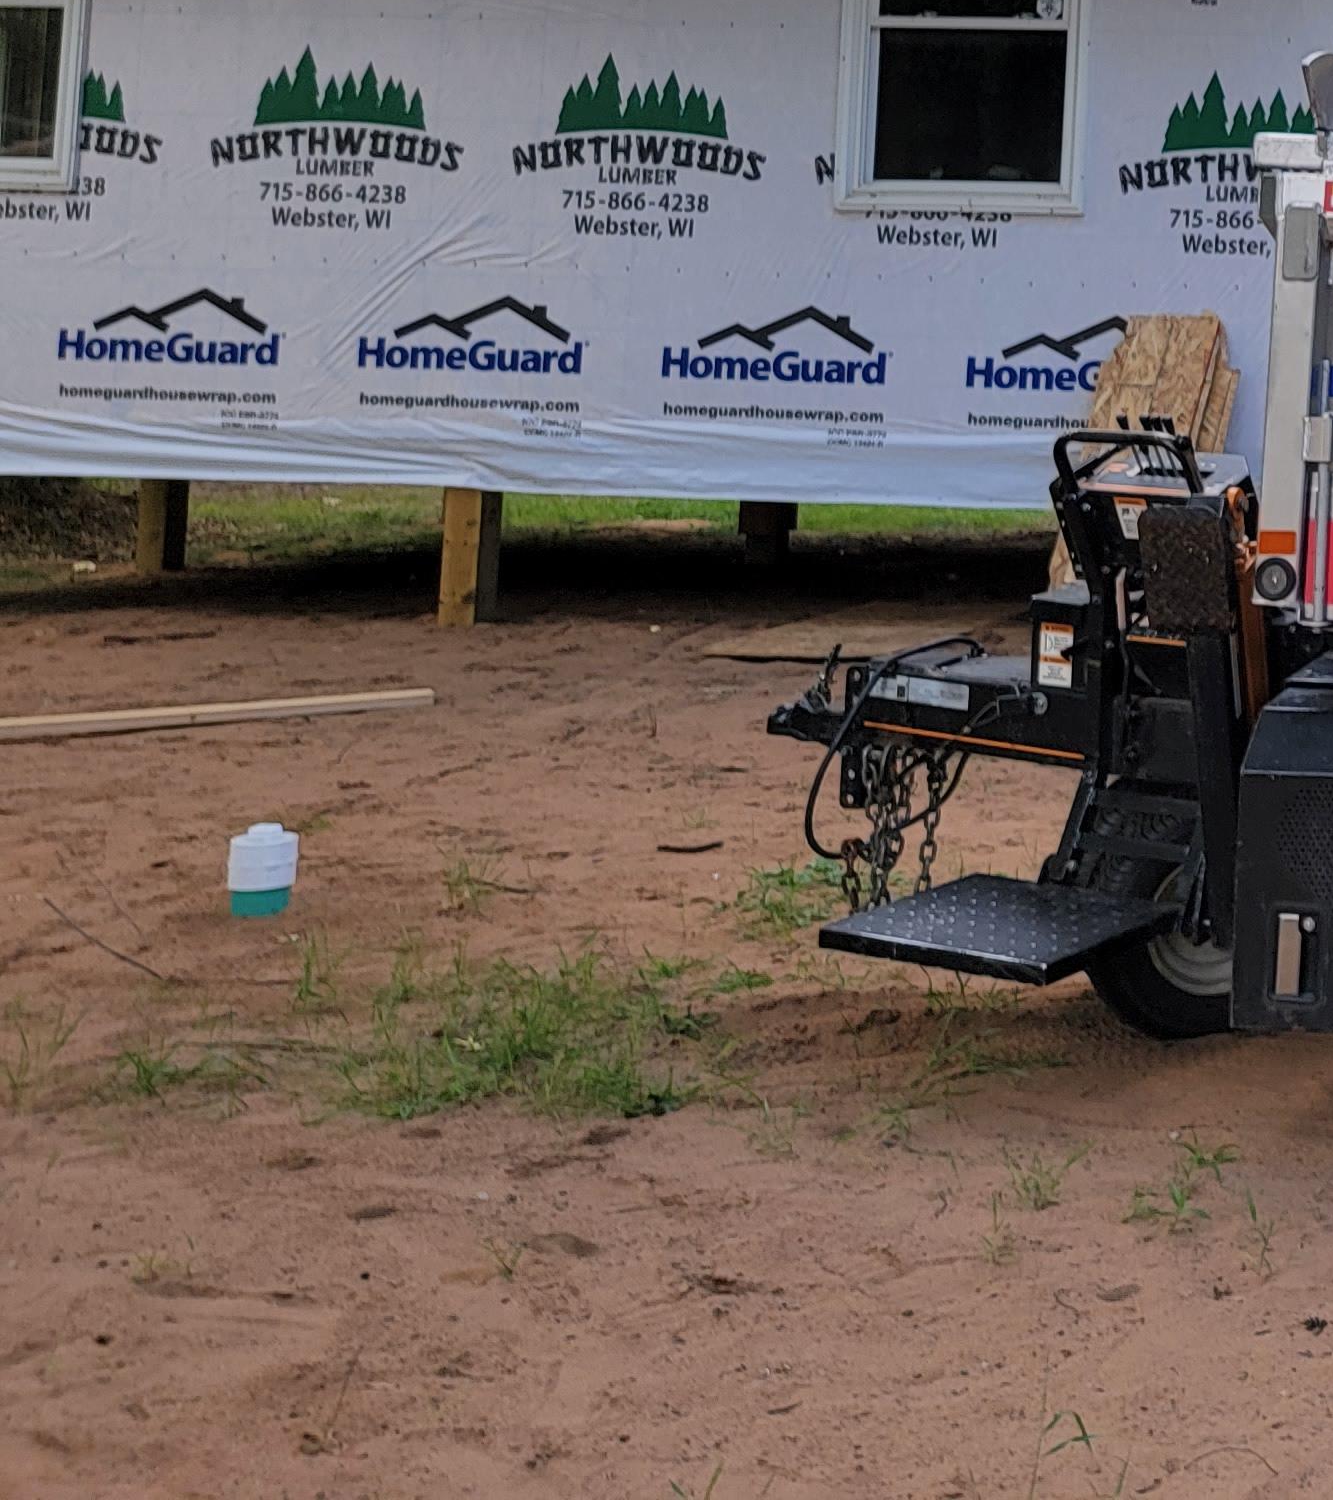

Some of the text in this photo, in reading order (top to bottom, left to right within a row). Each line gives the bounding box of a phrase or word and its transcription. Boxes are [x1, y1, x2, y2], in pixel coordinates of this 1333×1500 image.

[210, 126, 464, 173] NORTHWOODS
[512, 134, 767, 181] NORTHWOODS
[296, 158, 374, 177] LUMBER
[598, 166, 677, 186] LUMBER
[260, 182, 406, 205] 715-866-4238
[562, 189, 709, 213] 715-866-4238
[66, 200, 91, 221] WI
[272, 206, 391, 232] Webster, WI
[574, 214, 694, 240] Webster, WI
[877, 224, 998, 250] Webster, WI
[1182, 233, 1271, 259] Webster,
[58, 328, 280, 365] HomeGuard
[358, 336, 583, 374] HomeGuard
[661, 346, 887, 384] HomeGuard
[59, 383, 276, 405] homeguardhousewrap.com
[359, 392, 579, 414] homeguardhousewrap.com
[663, 401, 884, 424] homeguardhousewrap.com
